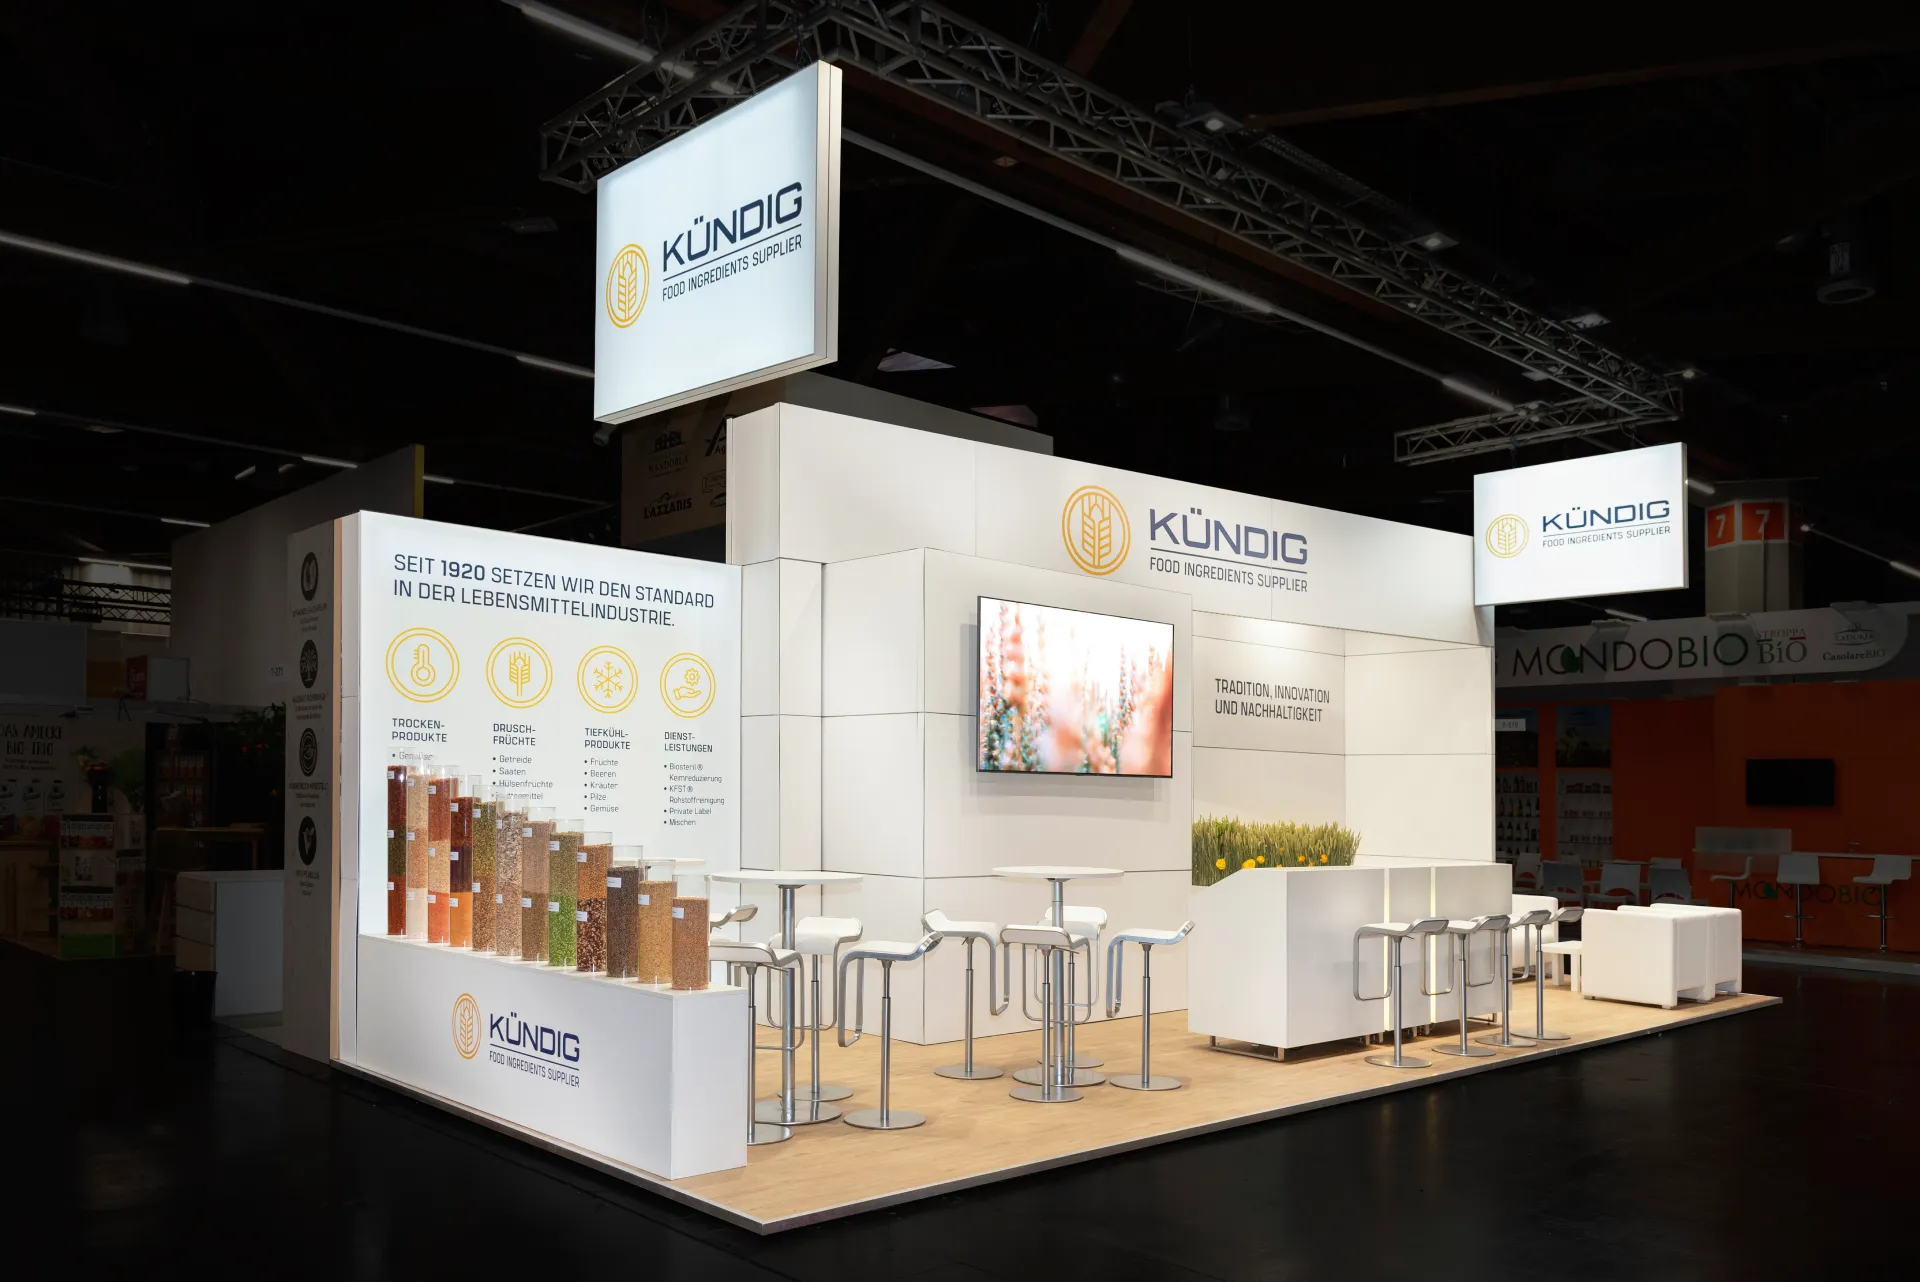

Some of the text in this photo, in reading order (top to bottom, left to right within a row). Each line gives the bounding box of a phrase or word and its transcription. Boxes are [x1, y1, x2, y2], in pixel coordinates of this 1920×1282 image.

[663, 182, 802, 272] KÜNDIG
[663, 234, 802, 301] FOOD INGREDIENTS SUPPLIER
[1542, 500, 1670, 532] KÜNDIG
[1756, 509, 1770, 533] 7
[1715, 514, 1726, 538] 7
[1150, 507, 1308, 565] KÜNDIG
[1542, 526, 1671, 548] FOOD INGREDIENTS SUPPLIER
[1150, 557, 1308, 592] FOOD INGREDIENTS SUPPLIER
[393, 554, 714, 608] SEIT 1920 SETZEN WIR DEN STANDARD
[393, 579, 675, 627] IN DER LEBENSMITTELINDUSTRIE.
[1512, 633, 1749, 676] MONDOBIO
[1215, 678, 1330, 704] TRADITION, INNOVATION
[1215, 699, 1323, 722] UND NACHHALTIGKEIT
[392, 718, 445, 729] TROCKEN-
[493, 723, 536, 734] DRUSCH-
[391, 731, 447, 742] PRODUKTE
[584, 727, 628, 738] TIEFKÜHL-
[664, 731, 695, 740] DIENST-
[493, 734, 536, 746] FRÜCHTE
[584, 740, 631, 750] PRODUKTE
[664, 743, 713, 753] LEISTUNGEN
[499, 755, 532, 764] Getreide
[499, 767, 526, 776] Saaten
[590, 770, 616, 778] Beeren
[590, 793, 606, 801] Pilze
[669, 796, 725, 805] Rohstoffreinigung
[590, 804, 619, 813] Gemüse
[669, 807, 712, 815] Private Label
[669, 818, 696, 826] Mischen
[490, 1011, 580, 1062] KÜNDIG
[489, 1050, 580, 1088] FOOD INGREDIENTS SUPPLIER
